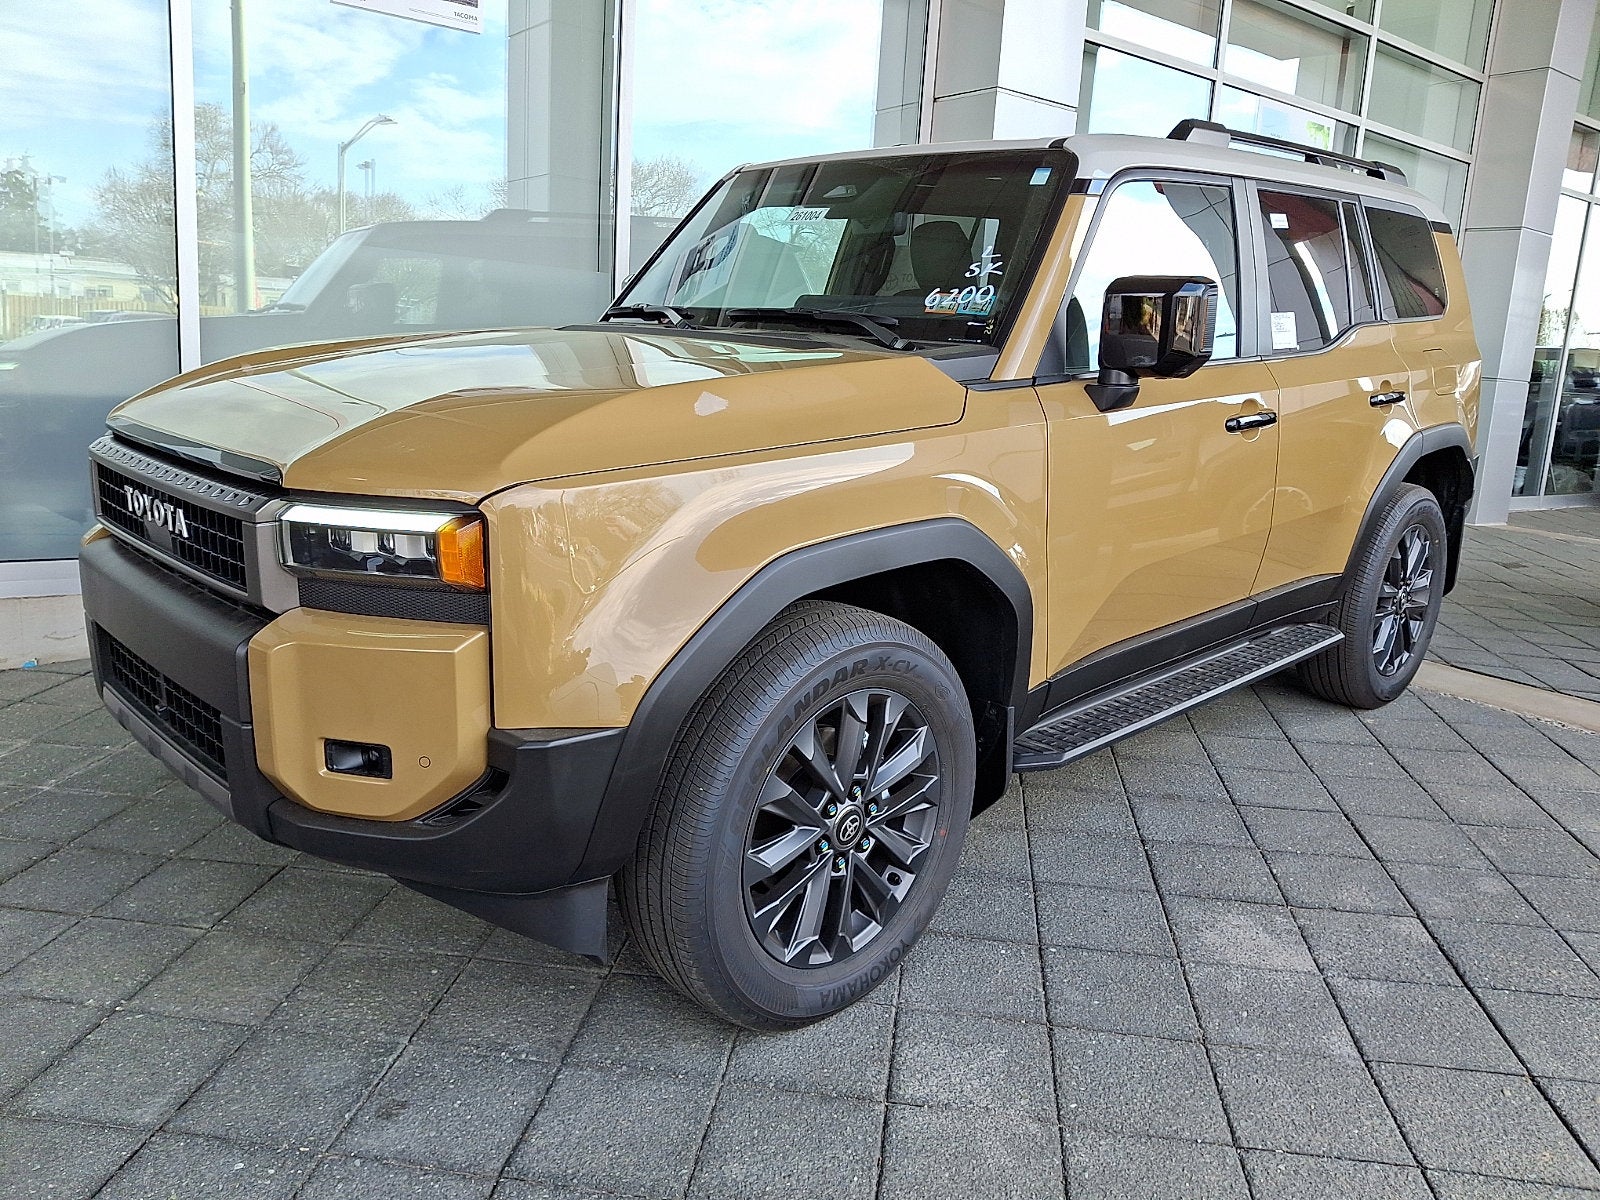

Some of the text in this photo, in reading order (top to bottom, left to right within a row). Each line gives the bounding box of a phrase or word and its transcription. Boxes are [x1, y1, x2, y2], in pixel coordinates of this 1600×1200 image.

[453, 11, 478, 21] TACOMA
[790, 210, 823, 221] 261004
[924, 285, 995, 307] 6200
[124, 485, 189, 538] TOYOTA
[819, 936, 912, 1009] YOKOHAMA
